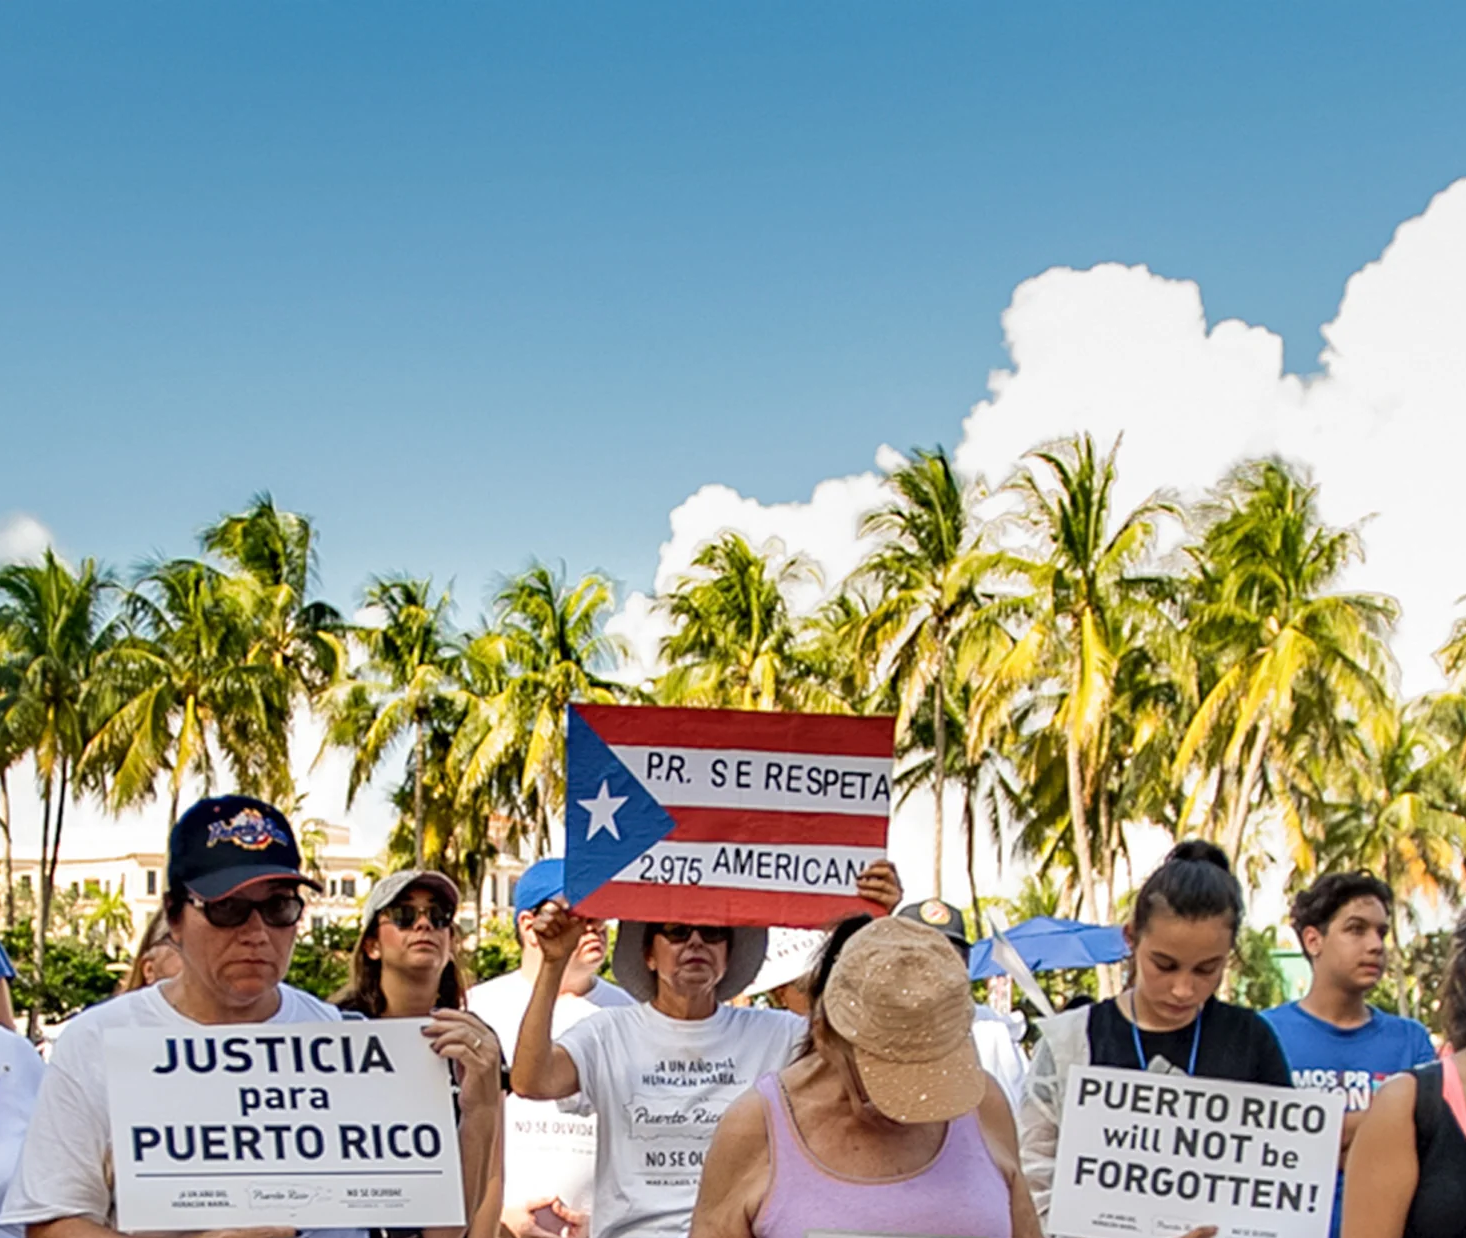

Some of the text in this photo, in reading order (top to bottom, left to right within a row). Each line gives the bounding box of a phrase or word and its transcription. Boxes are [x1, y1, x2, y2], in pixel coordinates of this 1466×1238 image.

[646, 752, 890, 801] P.R. SE RESPETA
[639, 854, 702, 886] 2,975
[153, 1035, 394, 1074] JUSTICIA
[239, 1086, 330, 1117] para
[634, 1106, 688, 1124] Puerto
[1078, 1077, 1326, 1134] PUERTO RICO
[131, 1124, 441, 1161] PUERTO RICO
[645, 1151, 666, 1167] NO
[669, 1151, 685, 1167] SE
[1103, 1125, 1299, 1169] will NOT be
[1074, 1156, 1319, 1213] FORGOTTEN!
